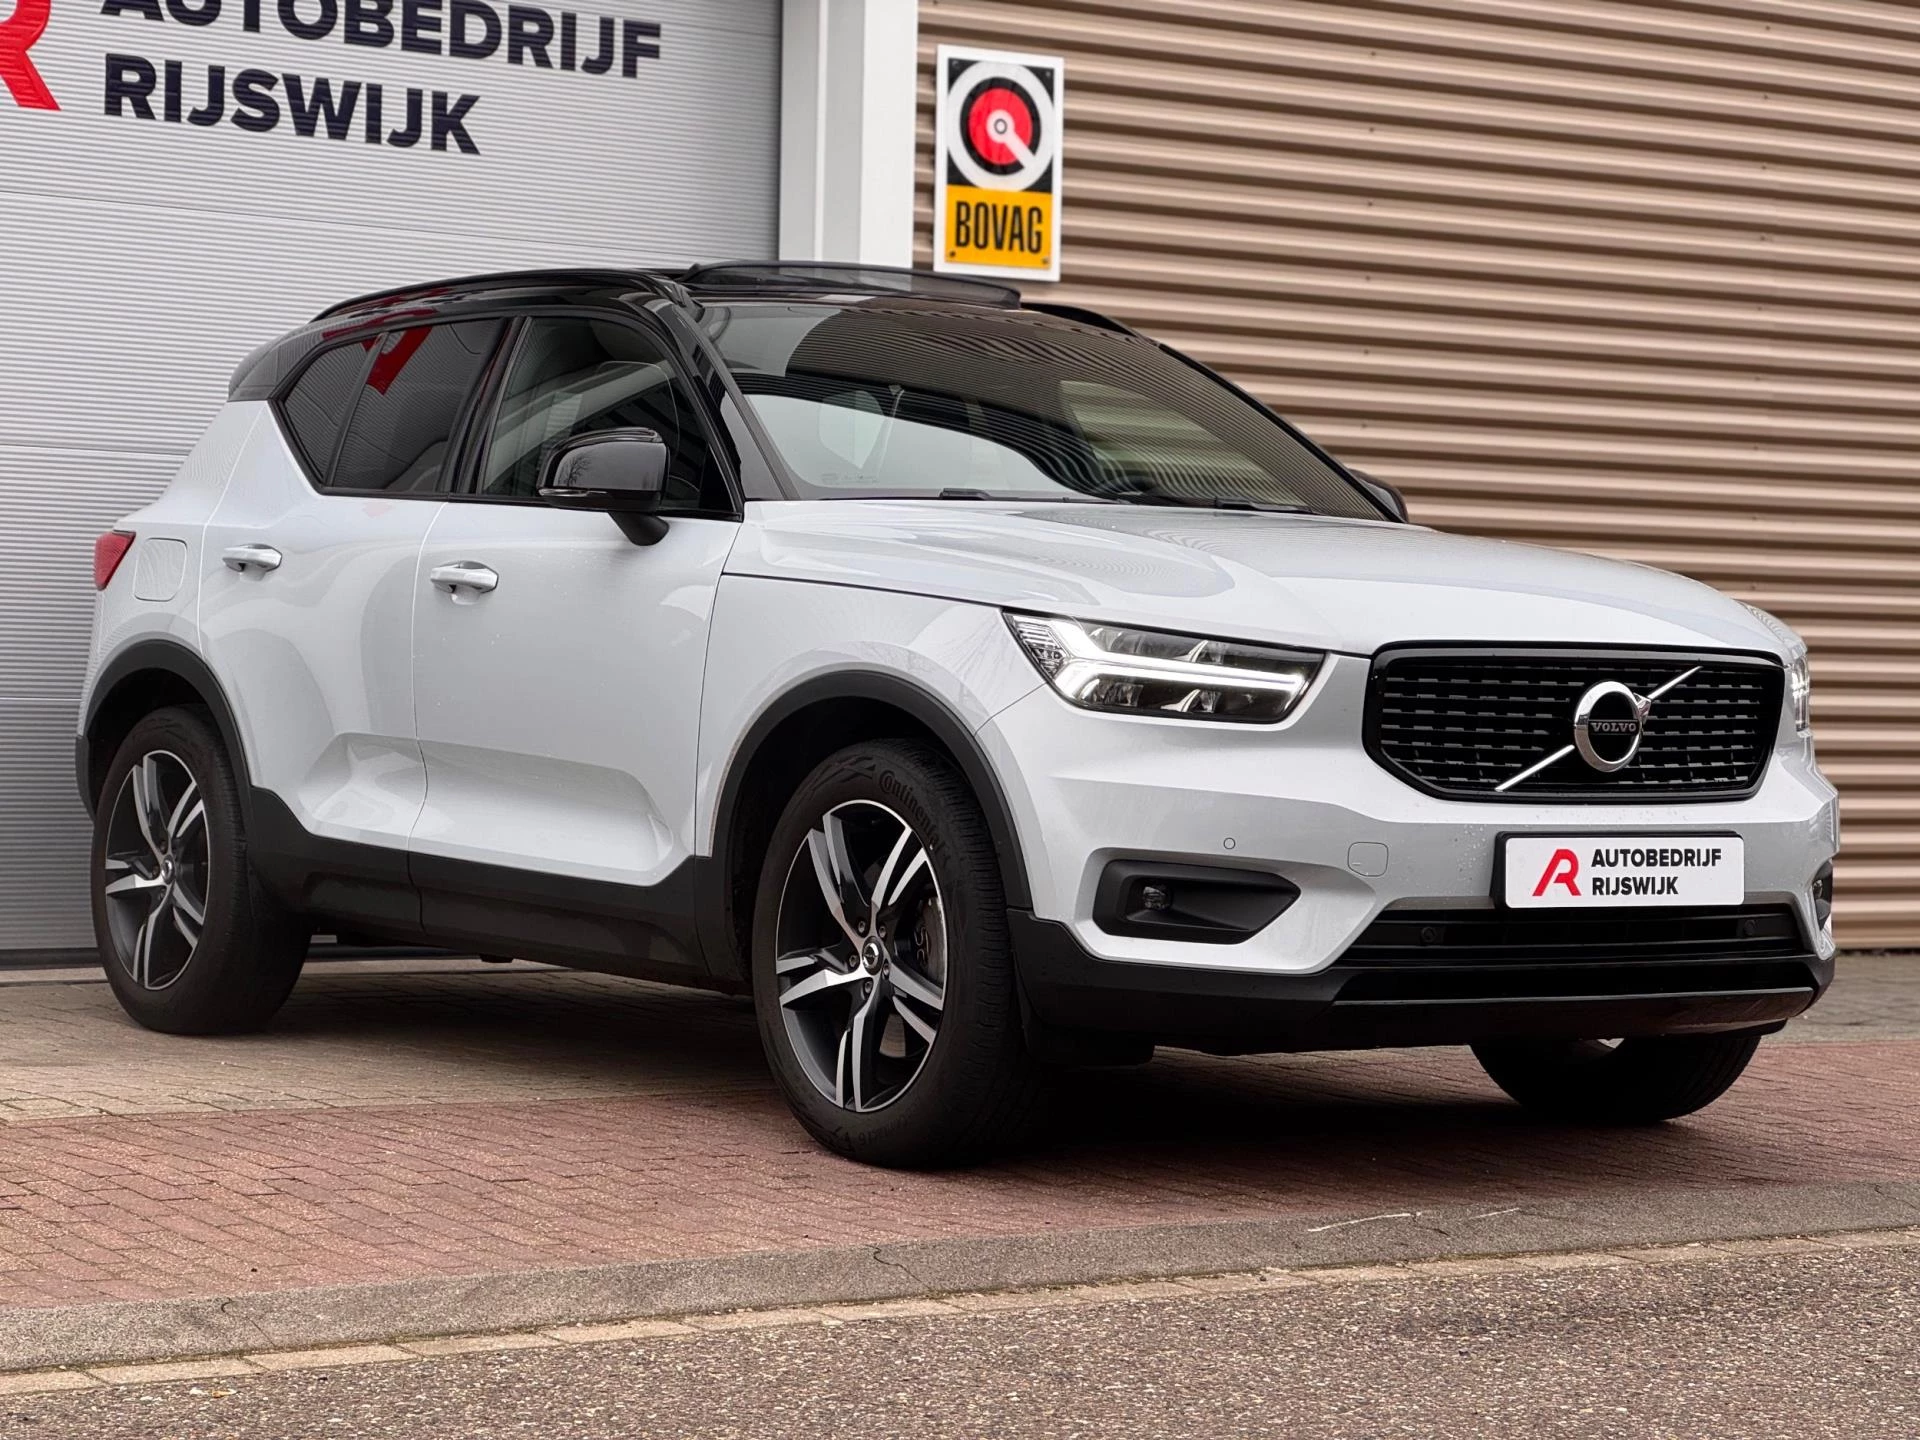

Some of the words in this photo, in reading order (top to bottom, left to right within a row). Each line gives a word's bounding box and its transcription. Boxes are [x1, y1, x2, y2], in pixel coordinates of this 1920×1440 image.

[101, 0, 660, 78] OBEDRIJF
[104, 53, 481, 155] RIJSWIJK
[955, 201, 1043, 254] BOVAG
[1590, 722, 1637, 732] VOLVO
[1591, 848, 1722, 867] AUTOBEDRIJF
[1592, 876, 1679, 895] RIJSWIJK
